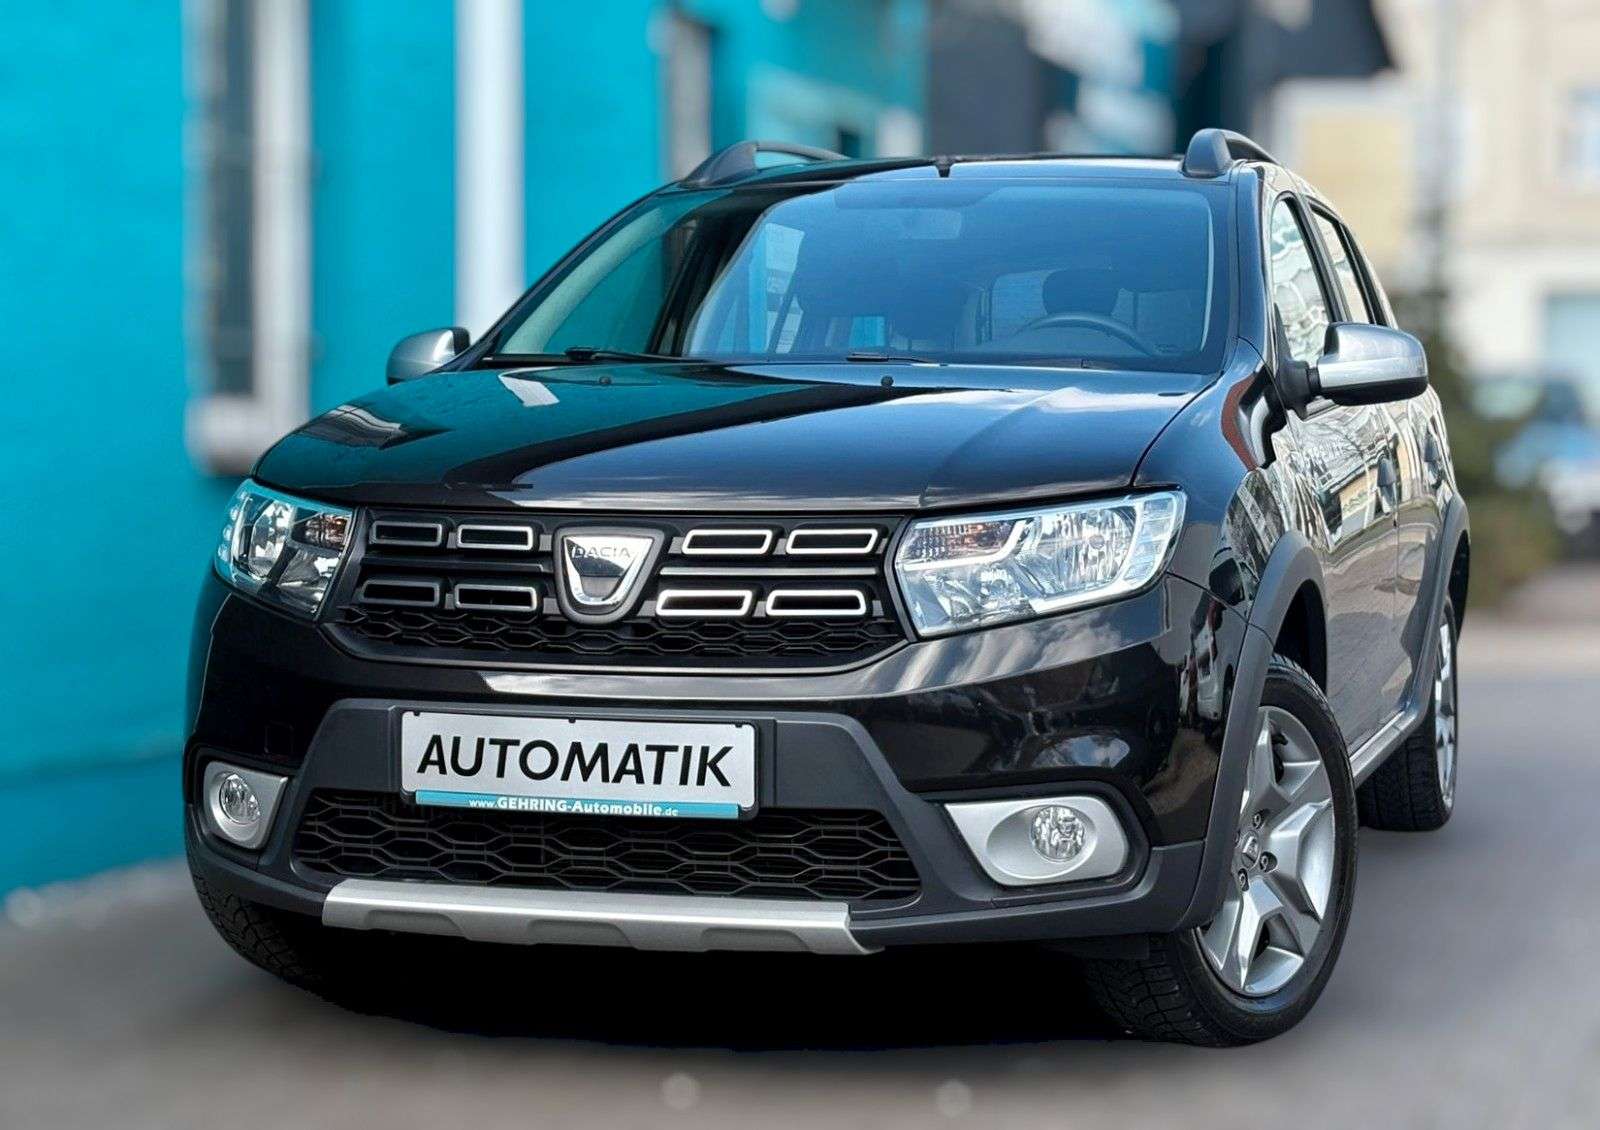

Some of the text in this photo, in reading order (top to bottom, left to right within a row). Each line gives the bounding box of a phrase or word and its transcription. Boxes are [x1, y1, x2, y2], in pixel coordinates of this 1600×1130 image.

[572, 545, 631, 559] DACIA
[417, 734, 734, 787] AUTOMATIK
[468, 796, 679, 817] www.GEHRING-Automobile.de
